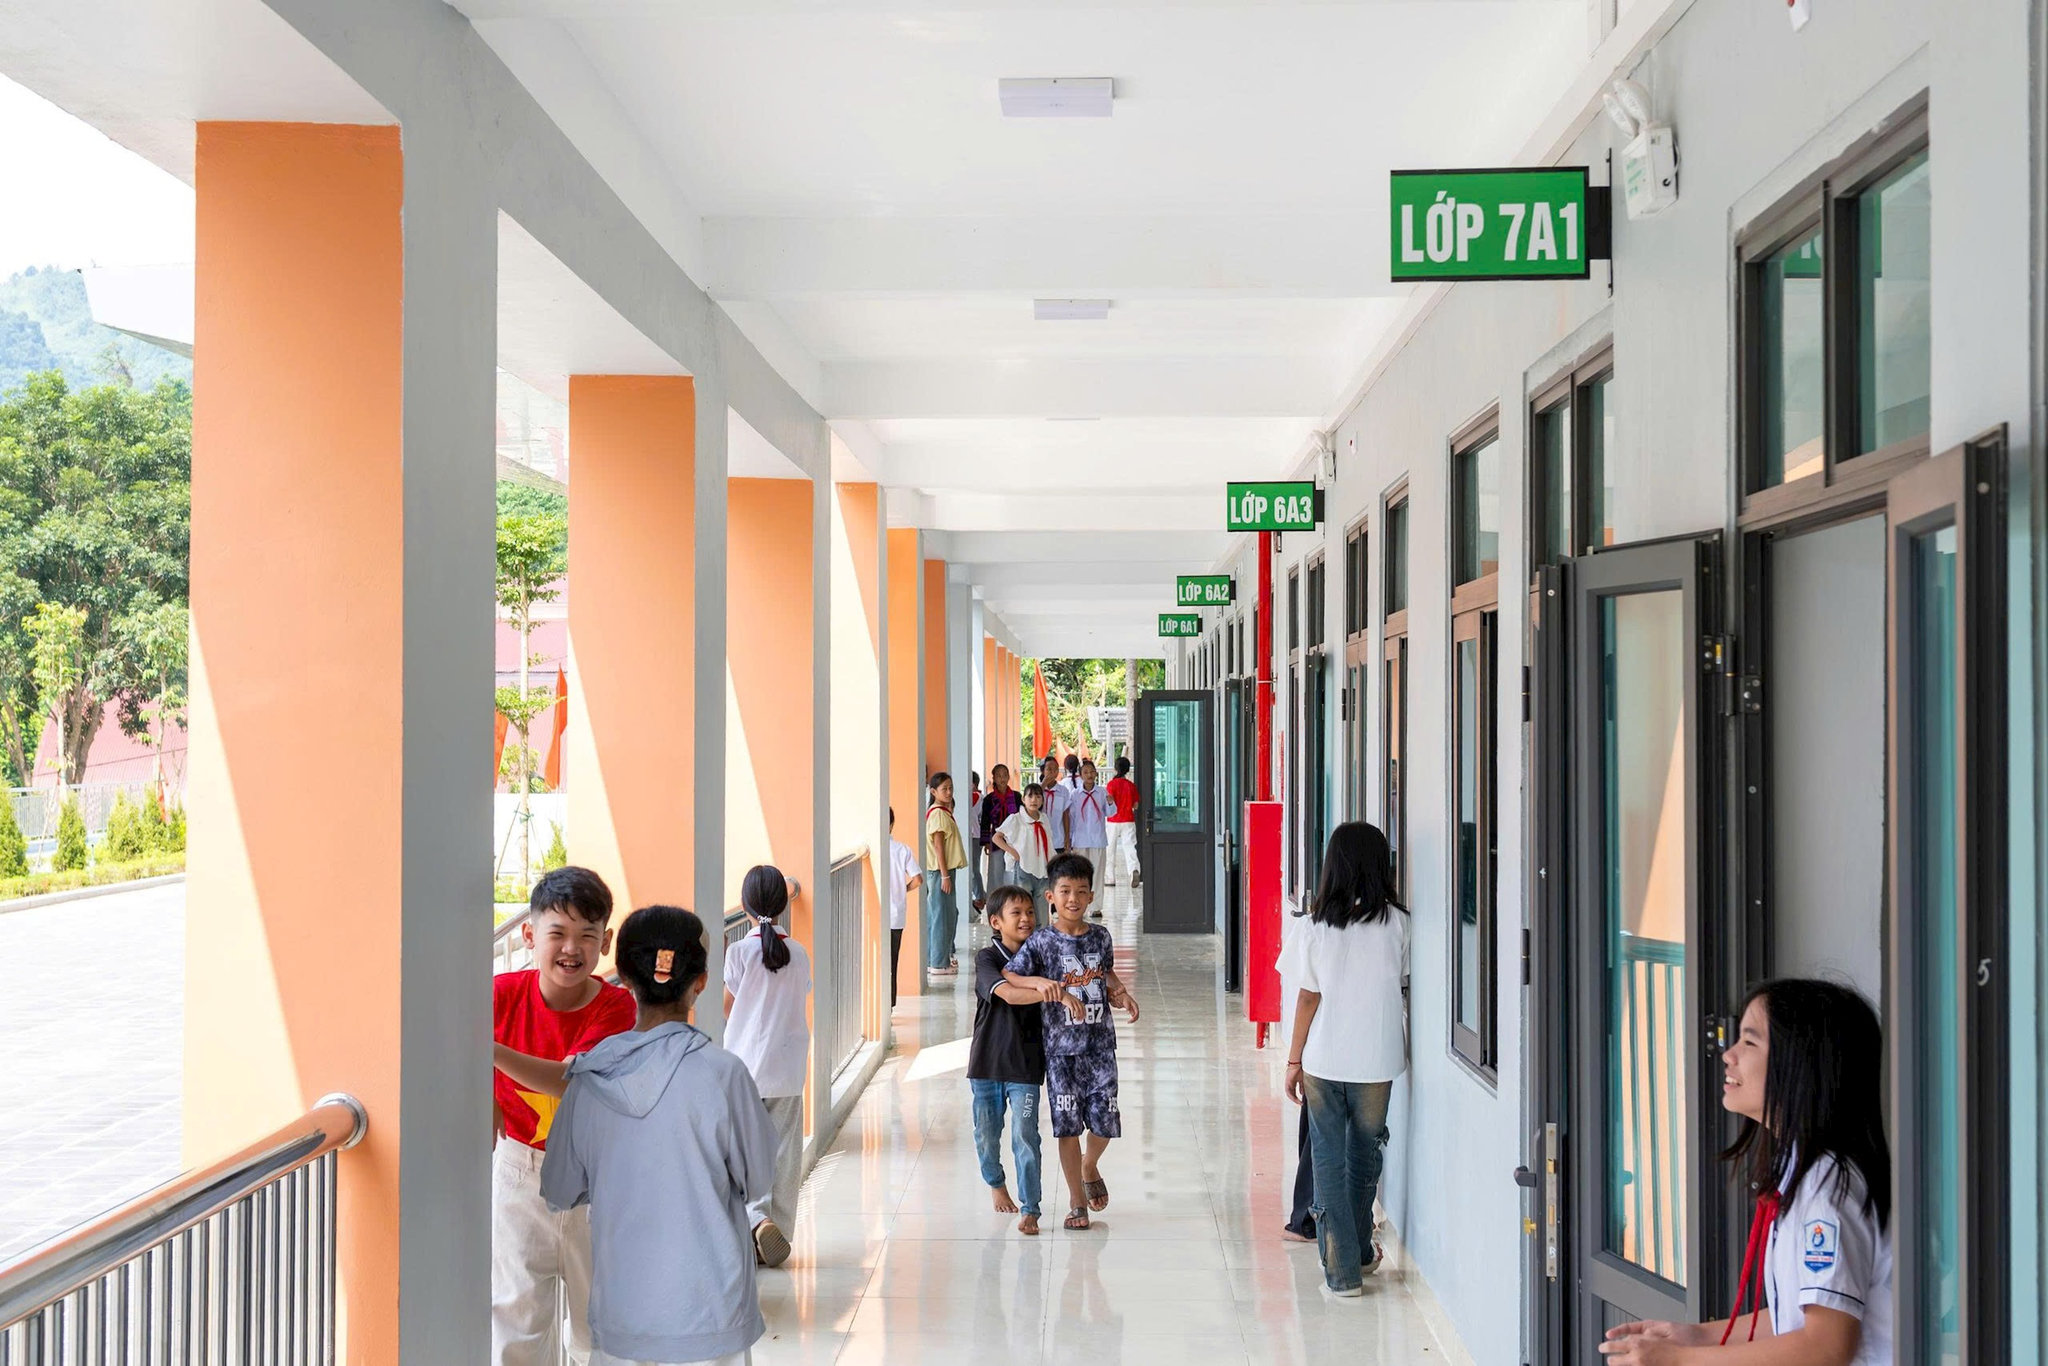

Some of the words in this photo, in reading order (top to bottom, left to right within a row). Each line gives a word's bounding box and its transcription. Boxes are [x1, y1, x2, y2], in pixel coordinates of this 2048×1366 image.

[1401, 190, 1485, 263] LỚP
[1498, 202, 1578, 261] 7A1
[1230, 490, 1268, 524] LỚP
[1274, 495, 1312, 523] 6A3
[1178, 580, 1202, 602] LỚP
[1205, 584, 1229, 602] 6A2
[1160, 617, 1178, 634] LỚP
[1180, 620, 1197, 634] 6A1
[1022, 1092, 1034, 1118] LEVIS
